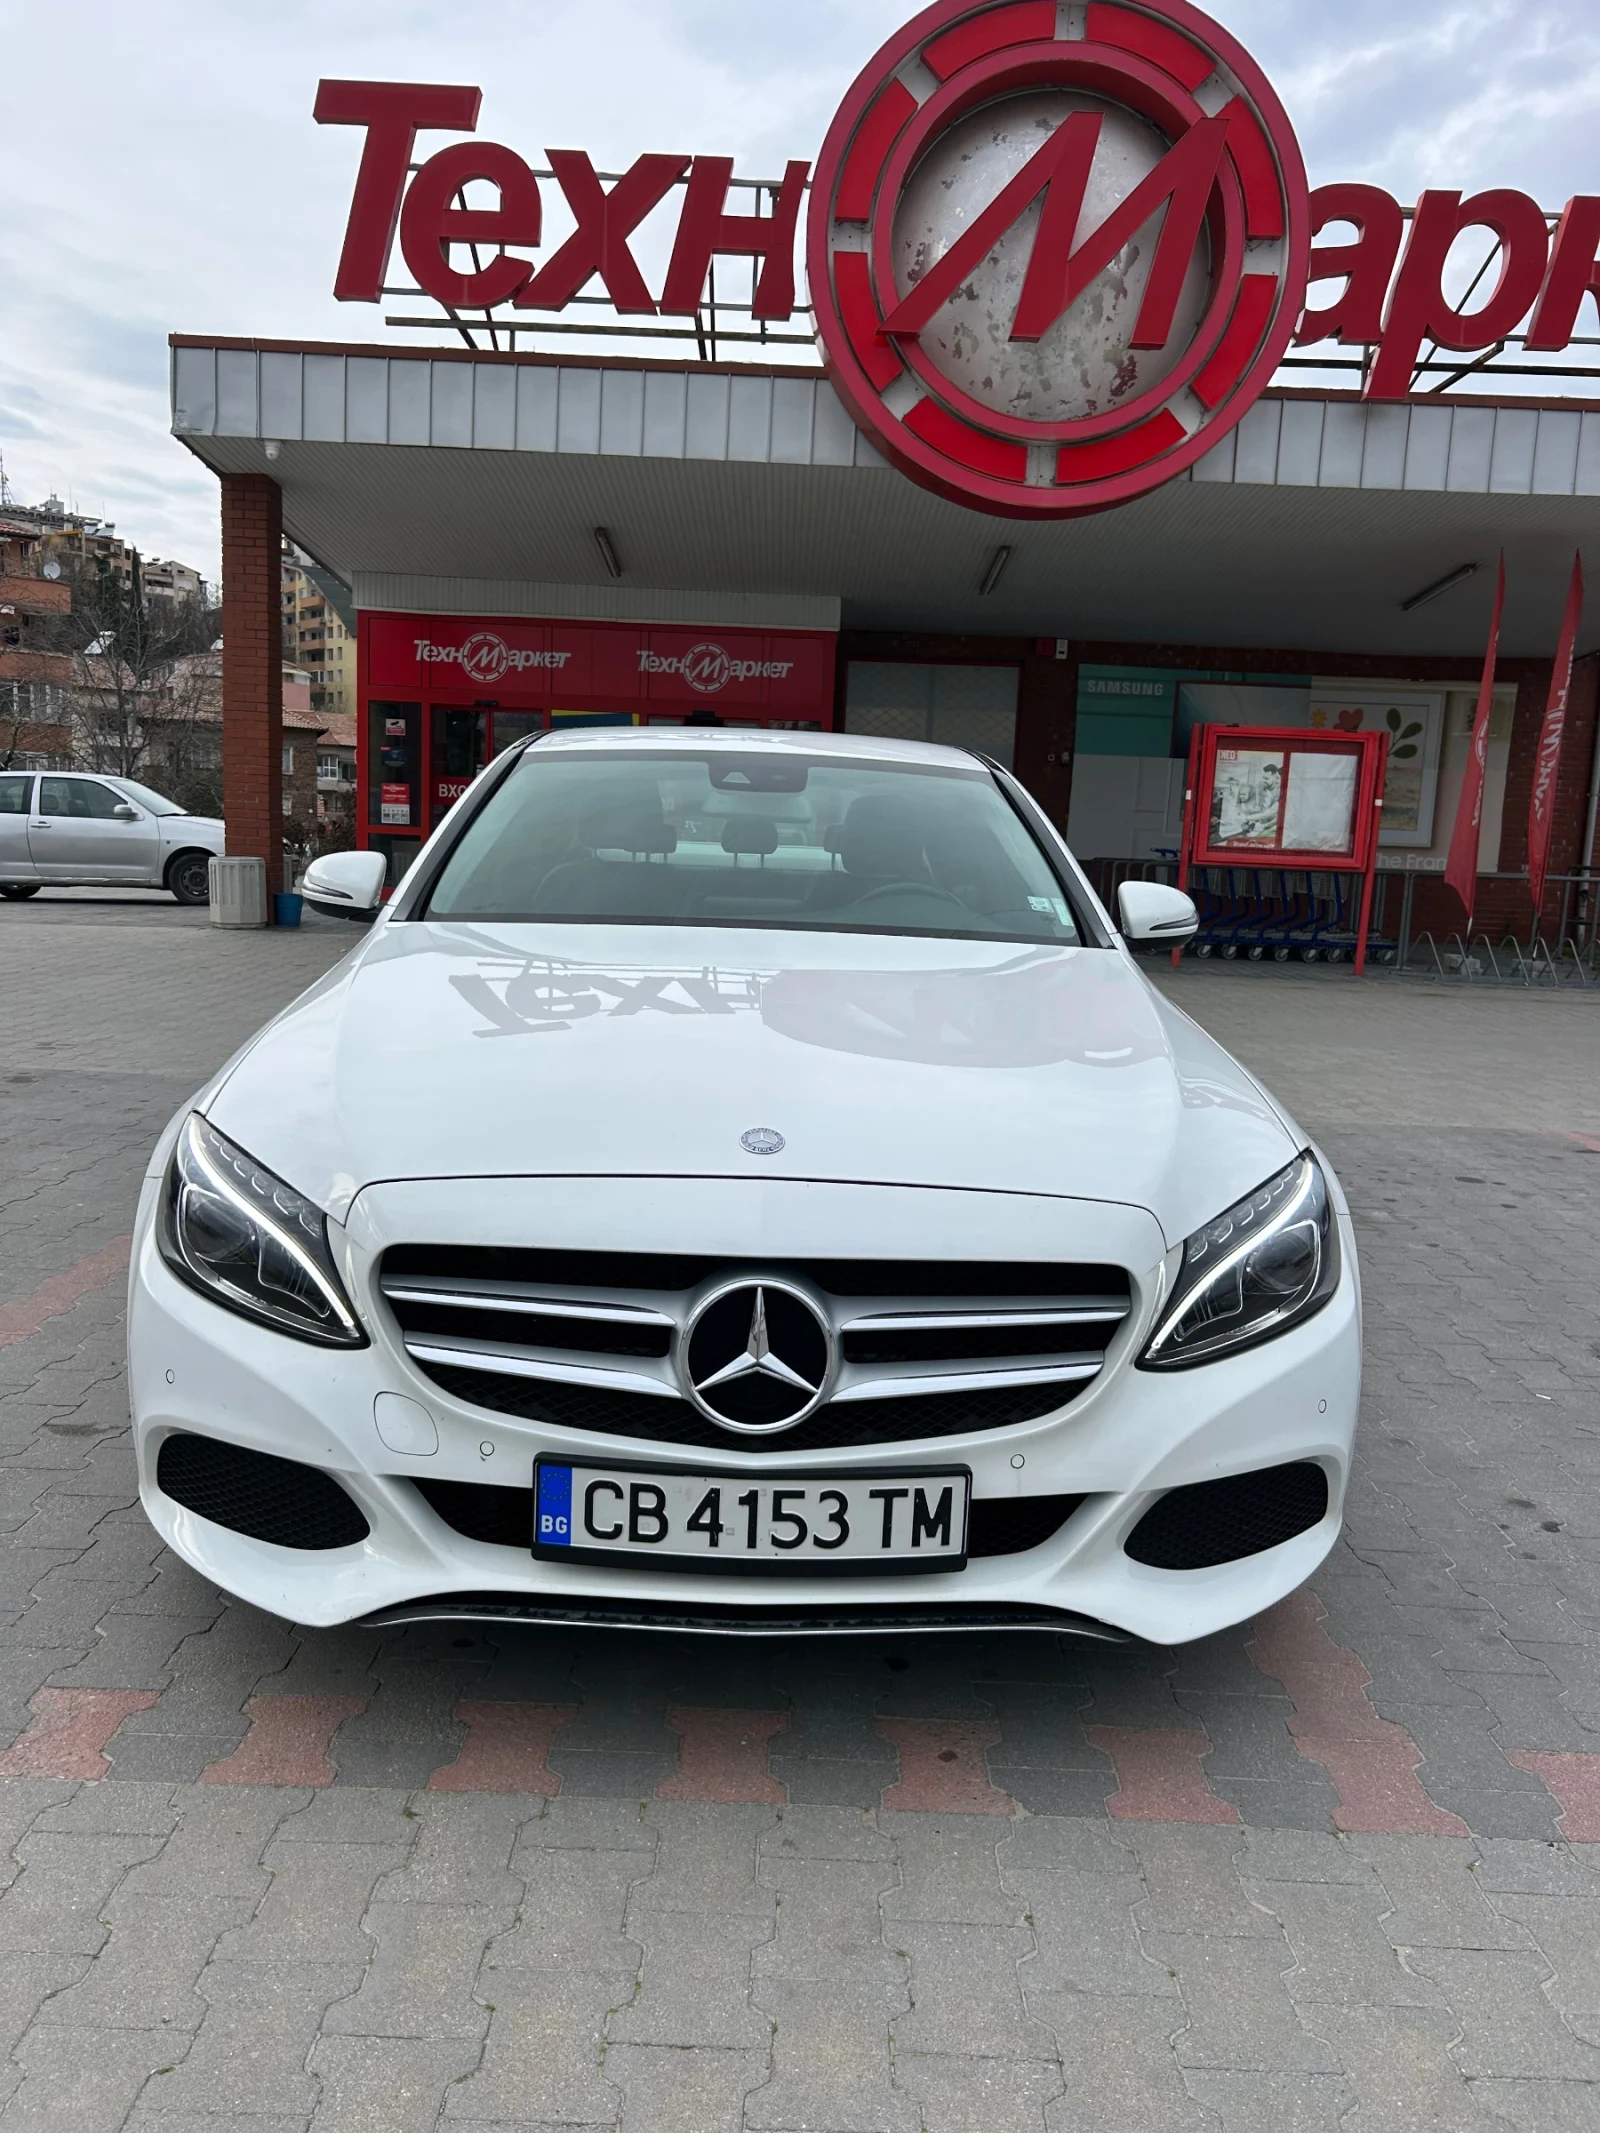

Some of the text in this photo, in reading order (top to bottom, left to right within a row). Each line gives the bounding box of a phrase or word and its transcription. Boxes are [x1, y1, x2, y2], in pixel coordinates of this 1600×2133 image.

[1087, 680, 1163, 696] SAMSUNG
[541, 1479, 953, 1549] BG CB 4153 TM
